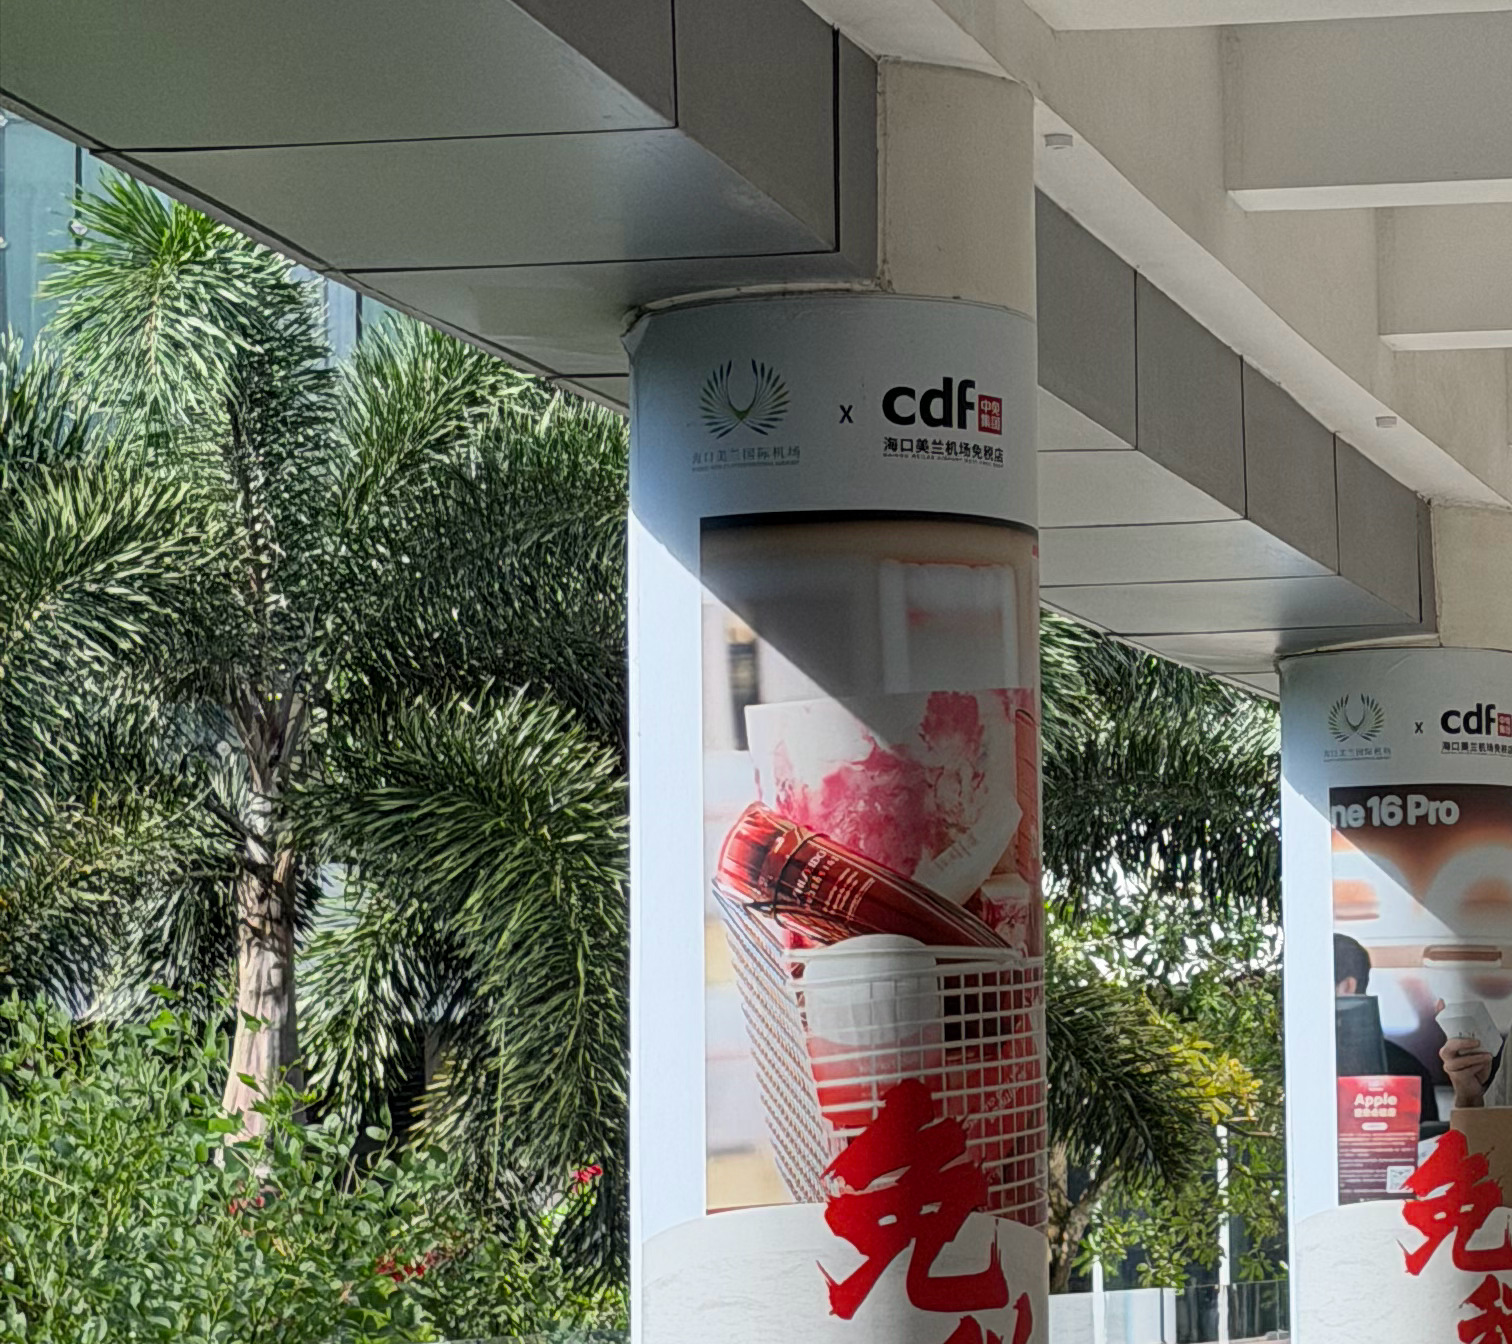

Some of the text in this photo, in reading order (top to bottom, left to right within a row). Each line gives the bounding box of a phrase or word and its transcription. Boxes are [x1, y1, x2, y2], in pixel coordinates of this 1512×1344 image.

[882, 376, 976, 430] cdf
[1441, 703, 1496, 735] cdf
[1367, 794, 1404, 827] 16
[1406, 794, 1460, 826] Pro
[1354, 1092, 1398, 1108] Apple
